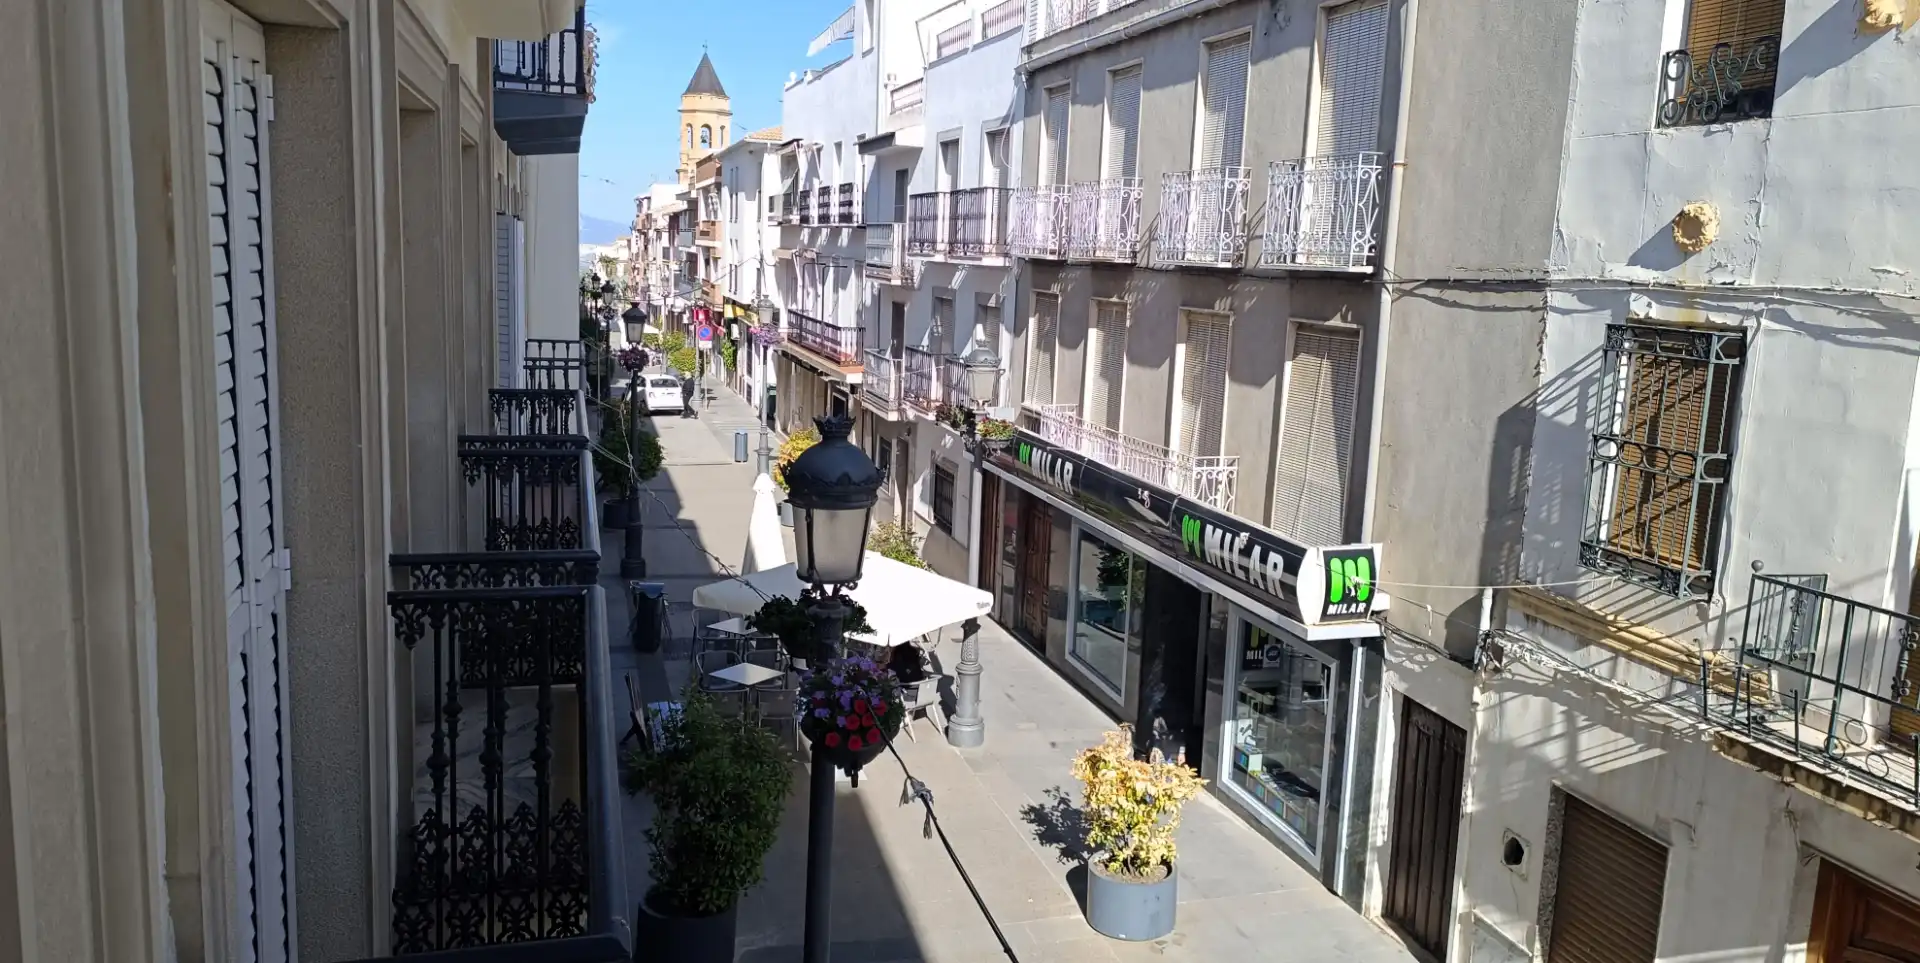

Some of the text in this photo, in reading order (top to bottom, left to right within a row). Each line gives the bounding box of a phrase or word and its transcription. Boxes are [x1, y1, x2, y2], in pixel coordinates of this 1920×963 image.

[1031, 446, 1074, 496] MILAR
[1204, 523, 1285, 601] MILAR
[1327, 602, 1367, 616] MILAR
[1246, 649, 1264, 661] MIL
